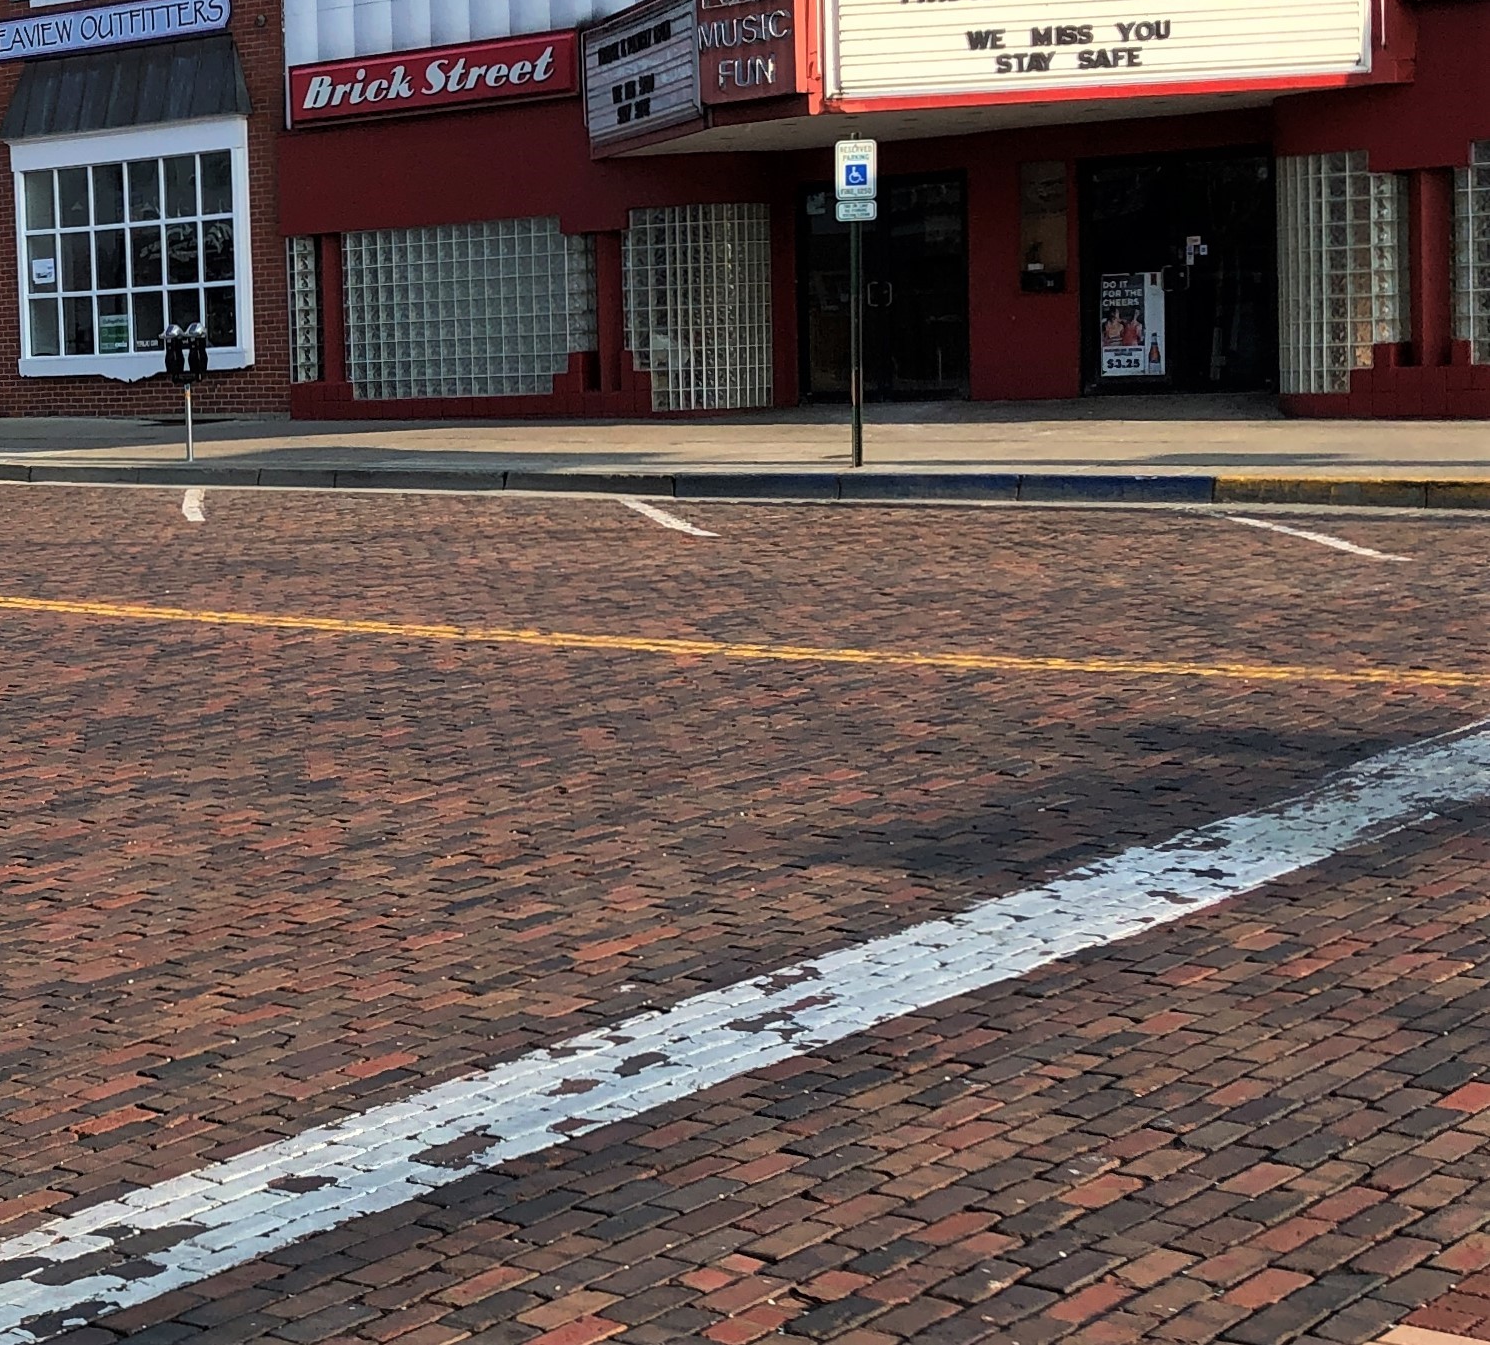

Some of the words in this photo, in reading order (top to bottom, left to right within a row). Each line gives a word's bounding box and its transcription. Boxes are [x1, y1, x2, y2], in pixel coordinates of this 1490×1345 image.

[697, 10, 791, 51] MUSIC
[966, 29, 1006, 51] WE
[1030, 24, 1093, 47] MISS
[1116, 19, 1171, 43] YOU
[718, 54, 777, 91] FUN
[996, 51, 1055, 74] STAY
[1078, 47, 1143, 70] SAFE
[302, 64, 414, 110] Brick
[421, 46, 554, 95] Street
[1102, 298, 1139, 306] CHEERS
[1103, 289, 1121, 297] FOR
[1107, 359, 1140, 368] $3.25
